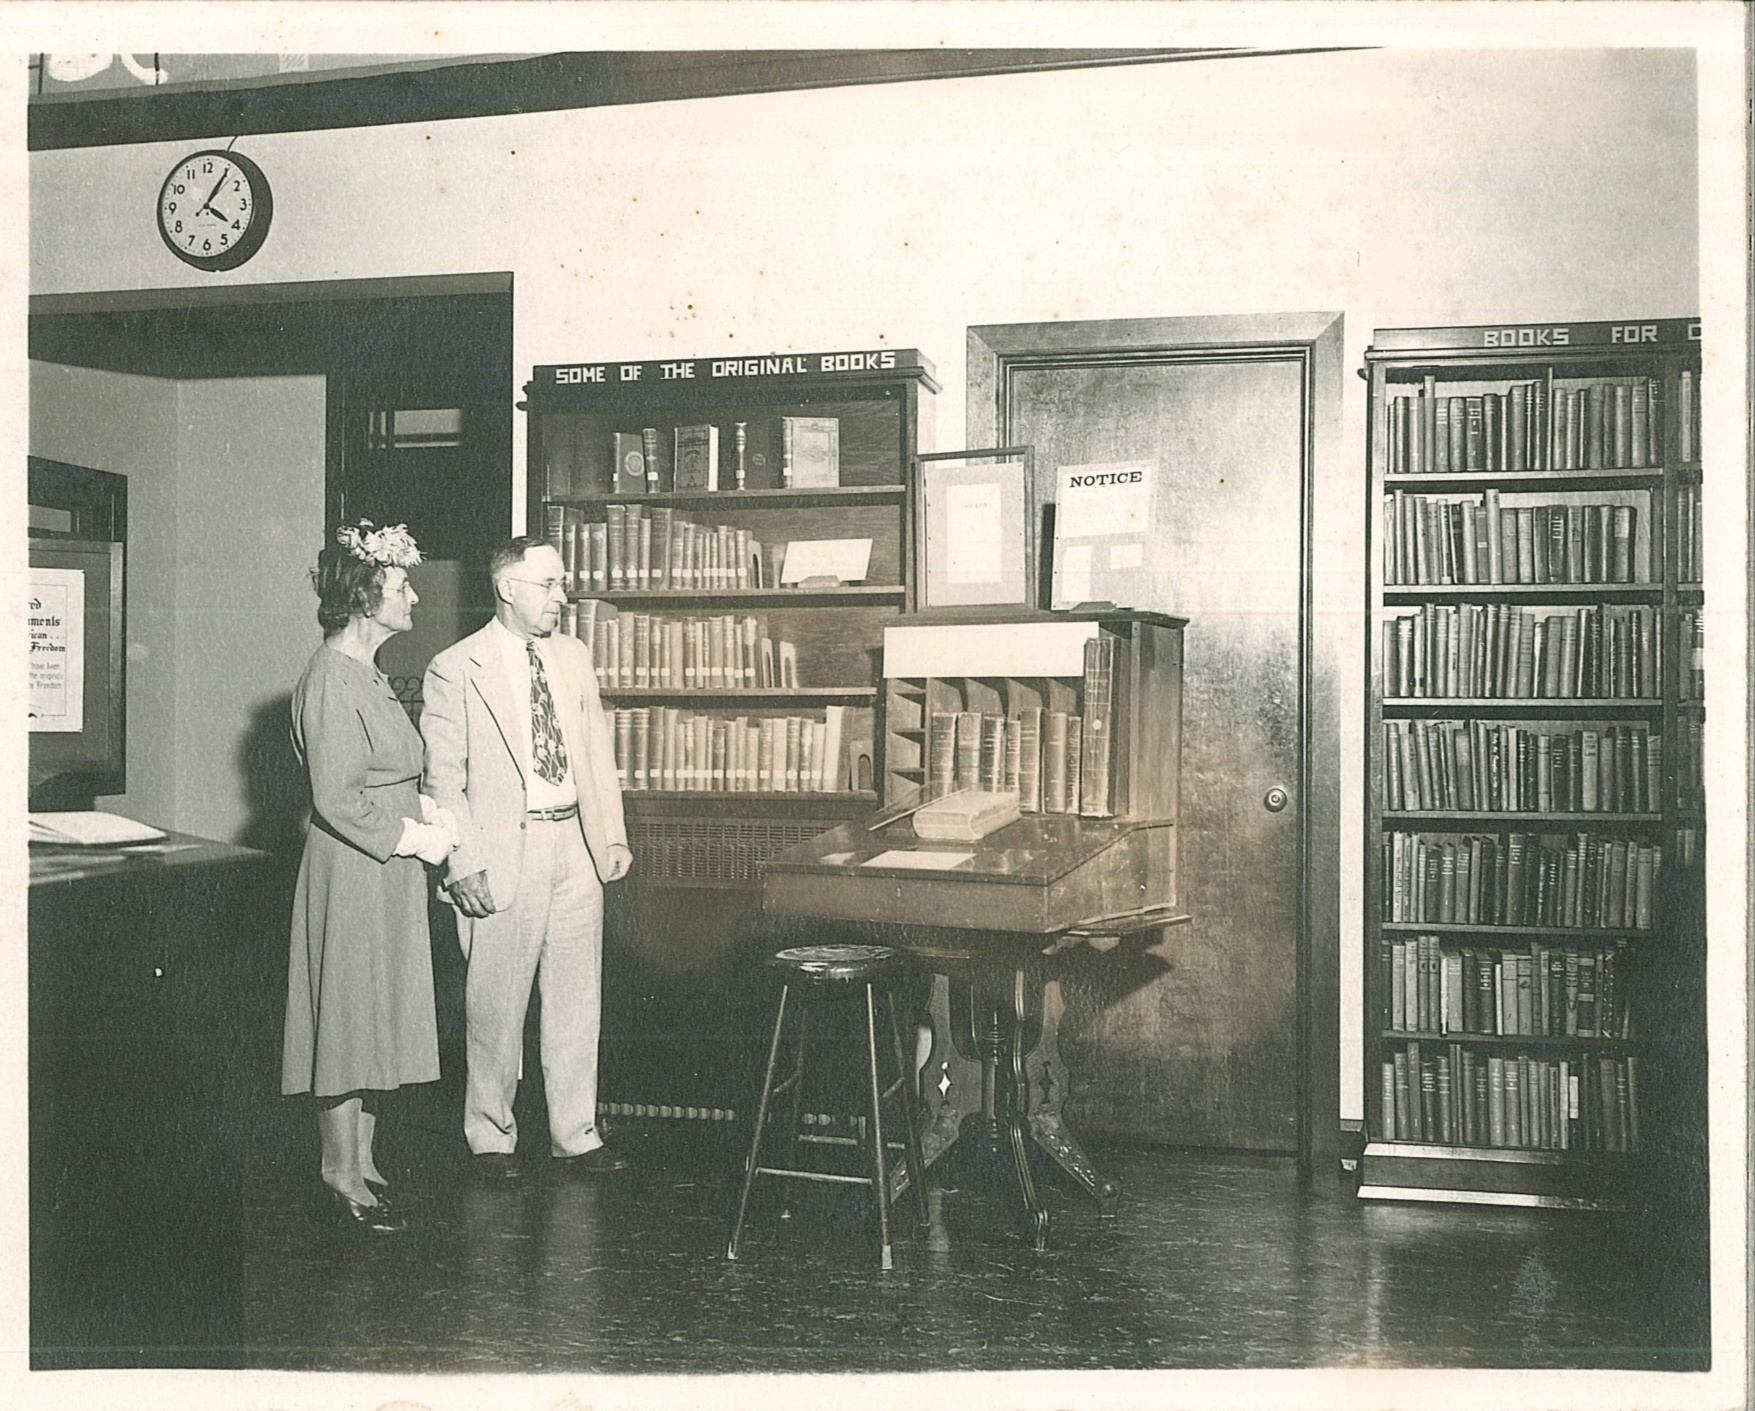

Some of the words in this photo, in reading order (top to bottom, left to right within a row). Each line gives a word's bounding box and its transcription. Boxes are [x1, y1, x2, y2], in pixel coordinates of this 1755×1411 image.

[203, 162, 213, 174] 12
[187, 169, 195, 180] 11
[174, 184, 185, 194] 10
[233, 180, 240, 192] 2
[169, 202, 177, 214] 9
[239, 198, 247, 211] 3
[175, 220, 183, 233] 8
[231, 219, 240, 230] 4
[188, 235, 196, 246] 7
[203, 238, 212, 251] 6
[220, 234, 228, 245] 5
[1483, 328, 1569, 347] BOOKS
[1611, 325, 1657, 343] FOR
[555, 365, 606, 384] SOME
[620, 365, 643, 381] OF
[660, 362, 695, 380] THE
[711, 356, 808, 377] ORIGINAL
[819, 351, 896, 372] BOOKS
[1070, 471, 1142, 488] NOTICE
[29, 641, 66, 653] Freedom
[37, 681, 63, 690] Freedom
